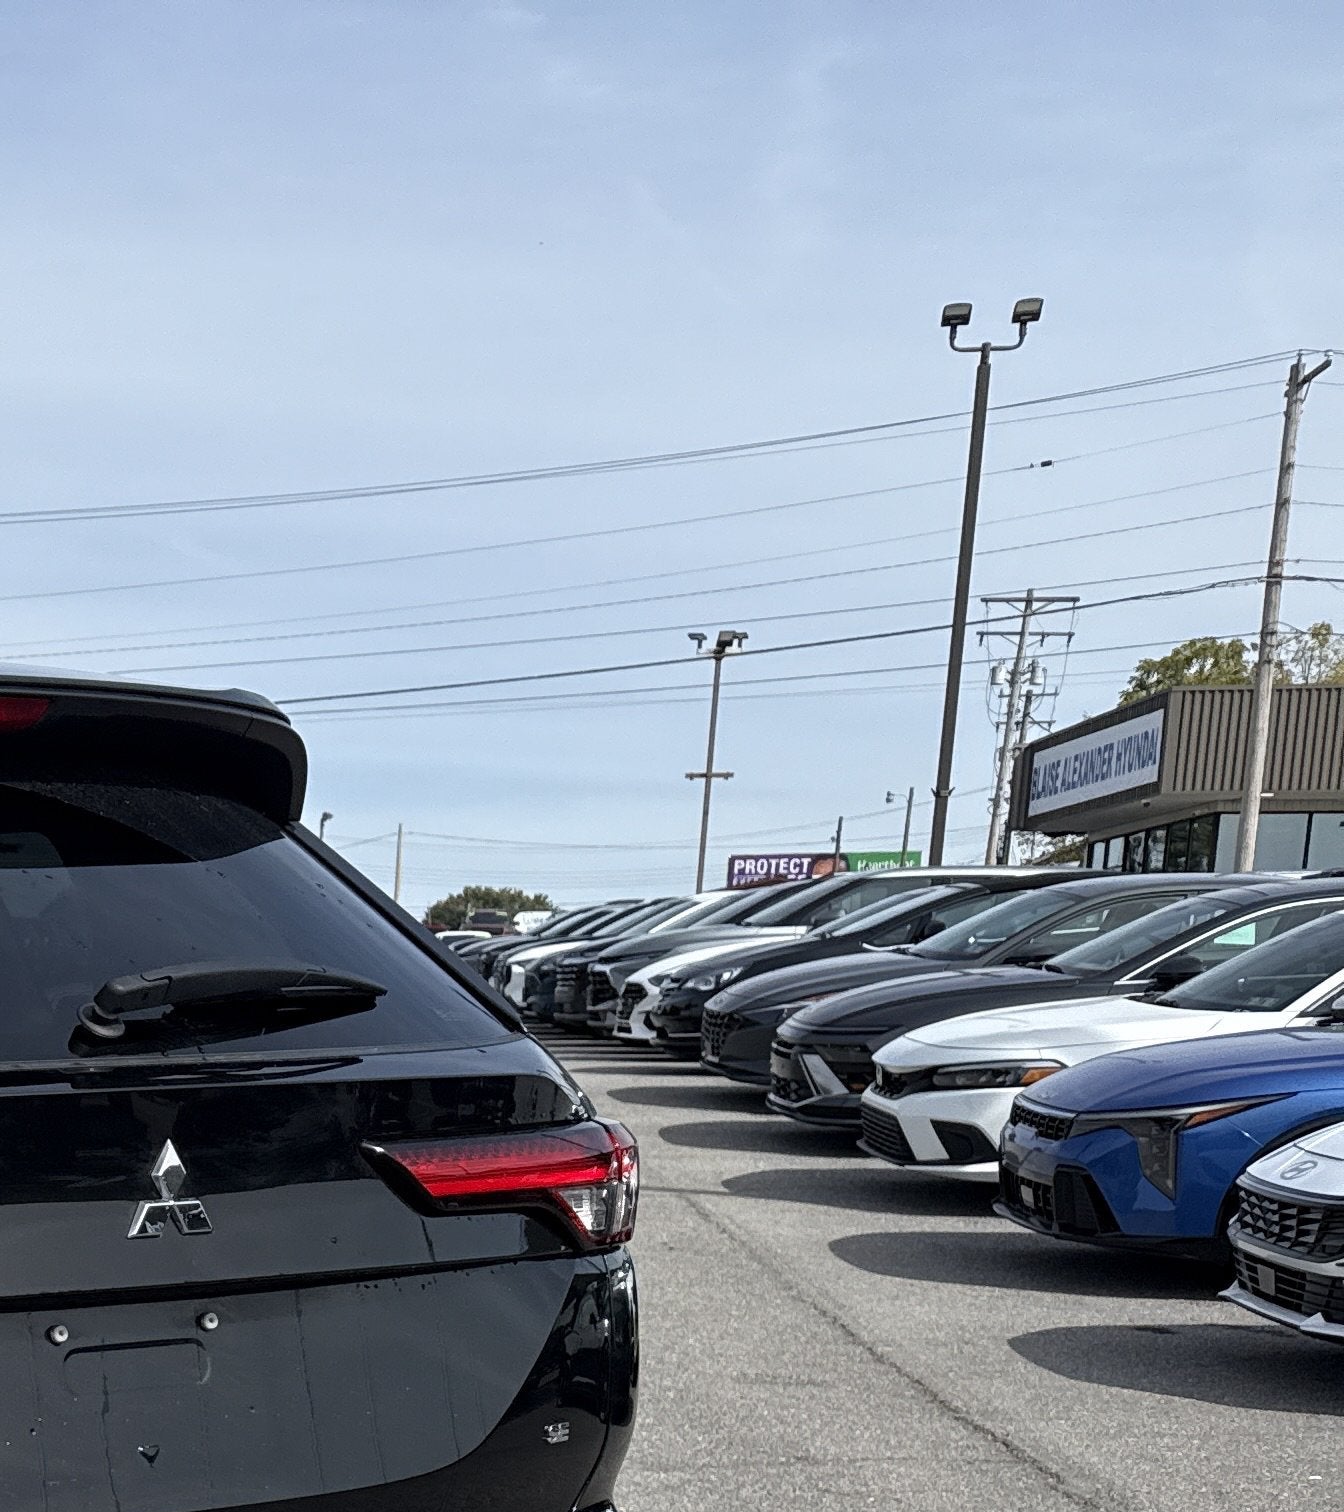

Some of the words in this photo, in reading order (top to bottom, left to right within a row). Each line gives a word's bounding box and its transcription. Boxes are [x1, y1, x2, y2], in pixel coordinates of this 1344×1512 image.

[1032, 760, 1061, 800] BLAISE
[1060, 743, 1114, 792] ALEXANDER
[1115, 727, 1159, 778] HYUNDAI
[734, 858, 811, 875] PROTECT
